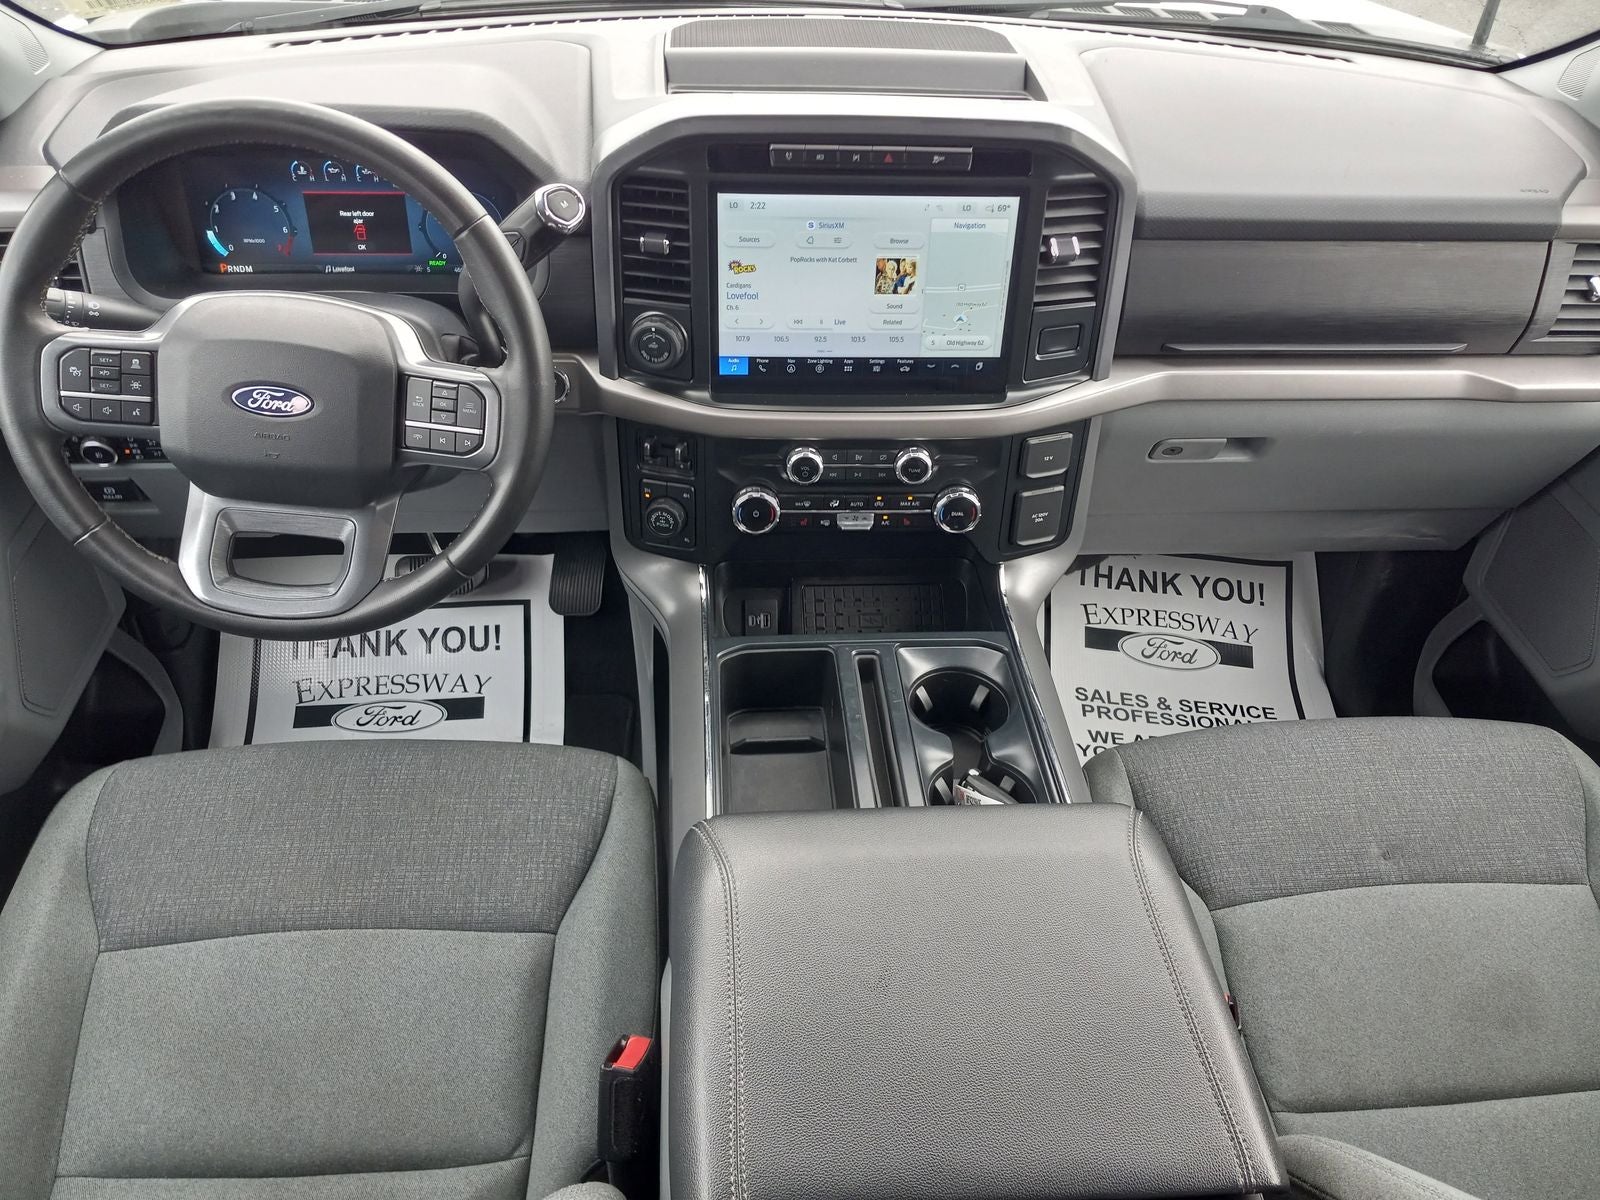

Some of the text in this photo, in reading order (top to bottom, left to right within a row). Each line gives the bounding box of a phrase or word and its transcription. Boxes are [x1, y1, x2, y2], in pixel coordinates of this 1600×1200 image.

[750, 201, 766, 209] 2:22
[997, 204, 1011, 212] 69°
[953, 222, 986, 230] Navigation
[726, 282, 752, 290] Cardigans
[726, 291, 759, 300] Lovefool
[955, 339, 977, 348] Highway
[247, 389, 297, 412] Ford
[253, 431, 291, 441] AIRBAG
[1079, 564, 1265, 607] THANK YOU!
[1080, 603, 1259, 645] EXPRESSWAY
[417, 624, 502, 655] YOU!
[1141, 636, 1199, 665] Ford
[291, 673, 494, 705] EXPRESSWAY
[1074, 686, 1278, 720] SALES & SERVICE
[354, 704, 422, 729] Ford
[1087, 729, 1124, 744] WE
